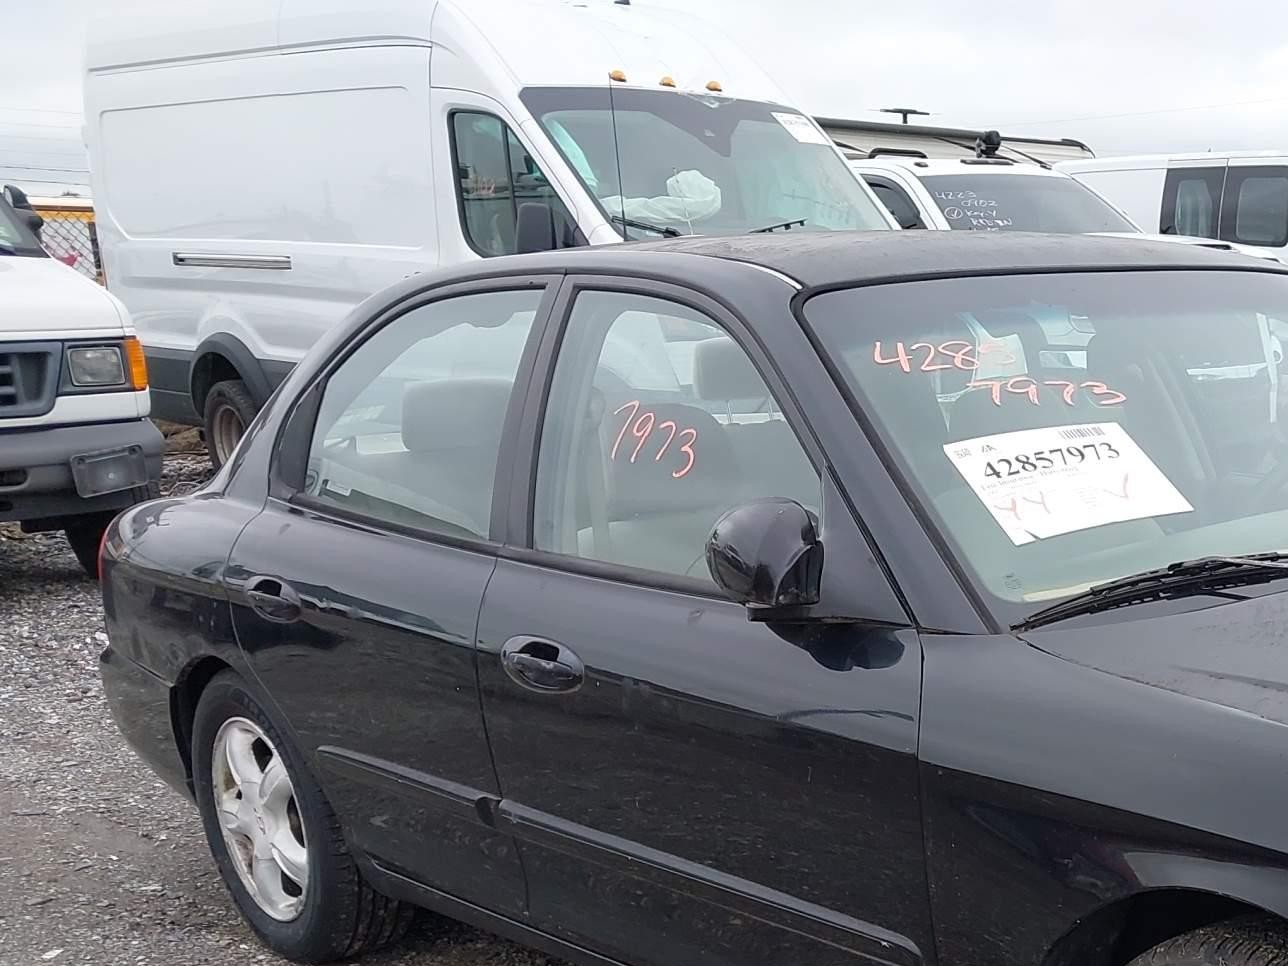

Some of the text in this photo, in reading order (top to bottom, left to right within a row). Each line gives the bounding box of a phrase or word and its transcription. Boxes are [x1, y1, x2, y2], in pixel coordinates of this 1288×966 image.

[967, 376, 1128, 407] 7973
[610, 399, 698, 479] 7973
[982, 441, 1121, 480] 42857973
